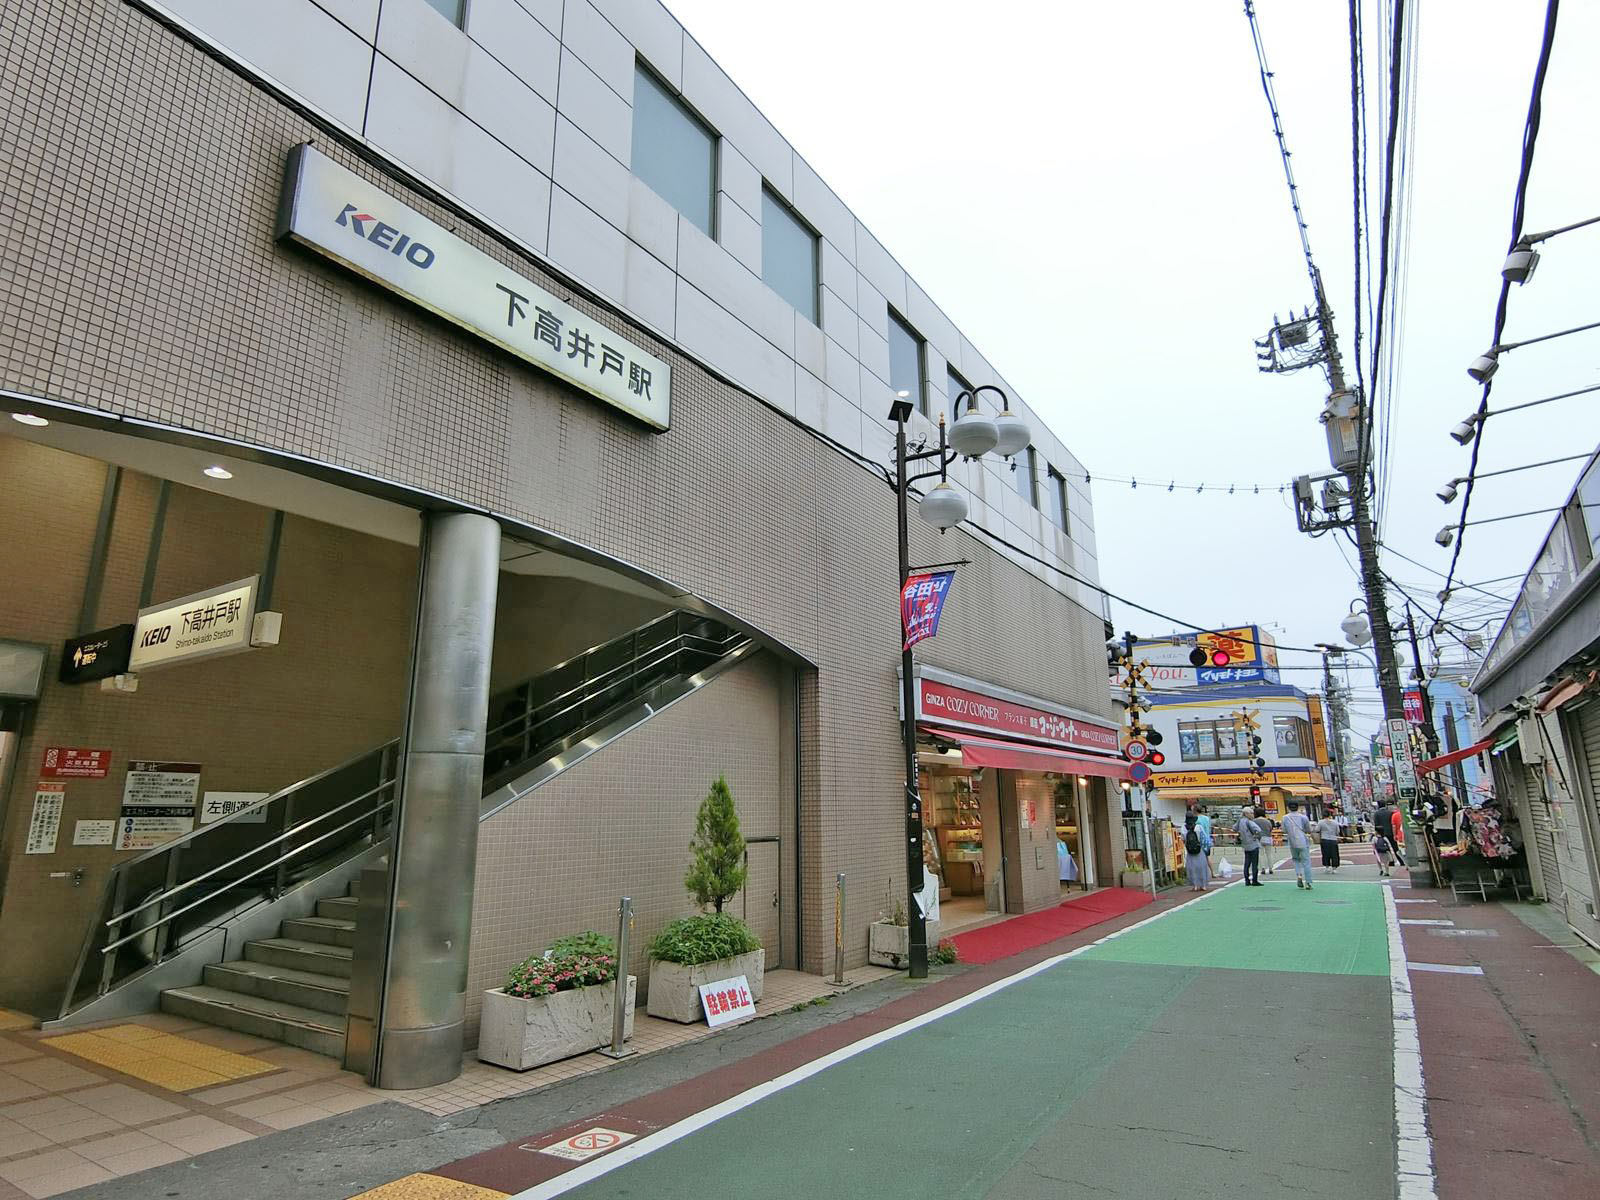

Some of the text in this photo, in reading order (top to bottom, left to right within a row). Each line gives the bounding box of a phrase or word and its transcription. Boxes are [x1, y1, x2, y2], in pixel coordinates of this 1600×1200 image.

[335, 202, 436, 270] KEIO
[495, 282, 652, 401] 下高井戸駅
[181, 597, 242, 635] 下高井戸駅
[140, 625, 172, 648] KEIO
[175, 628, 234, 649] Shimo-takaido Station
[925, 692, 999, 722] GINZA COZY CORNER
[1130, 745, 1143, 755] 30
